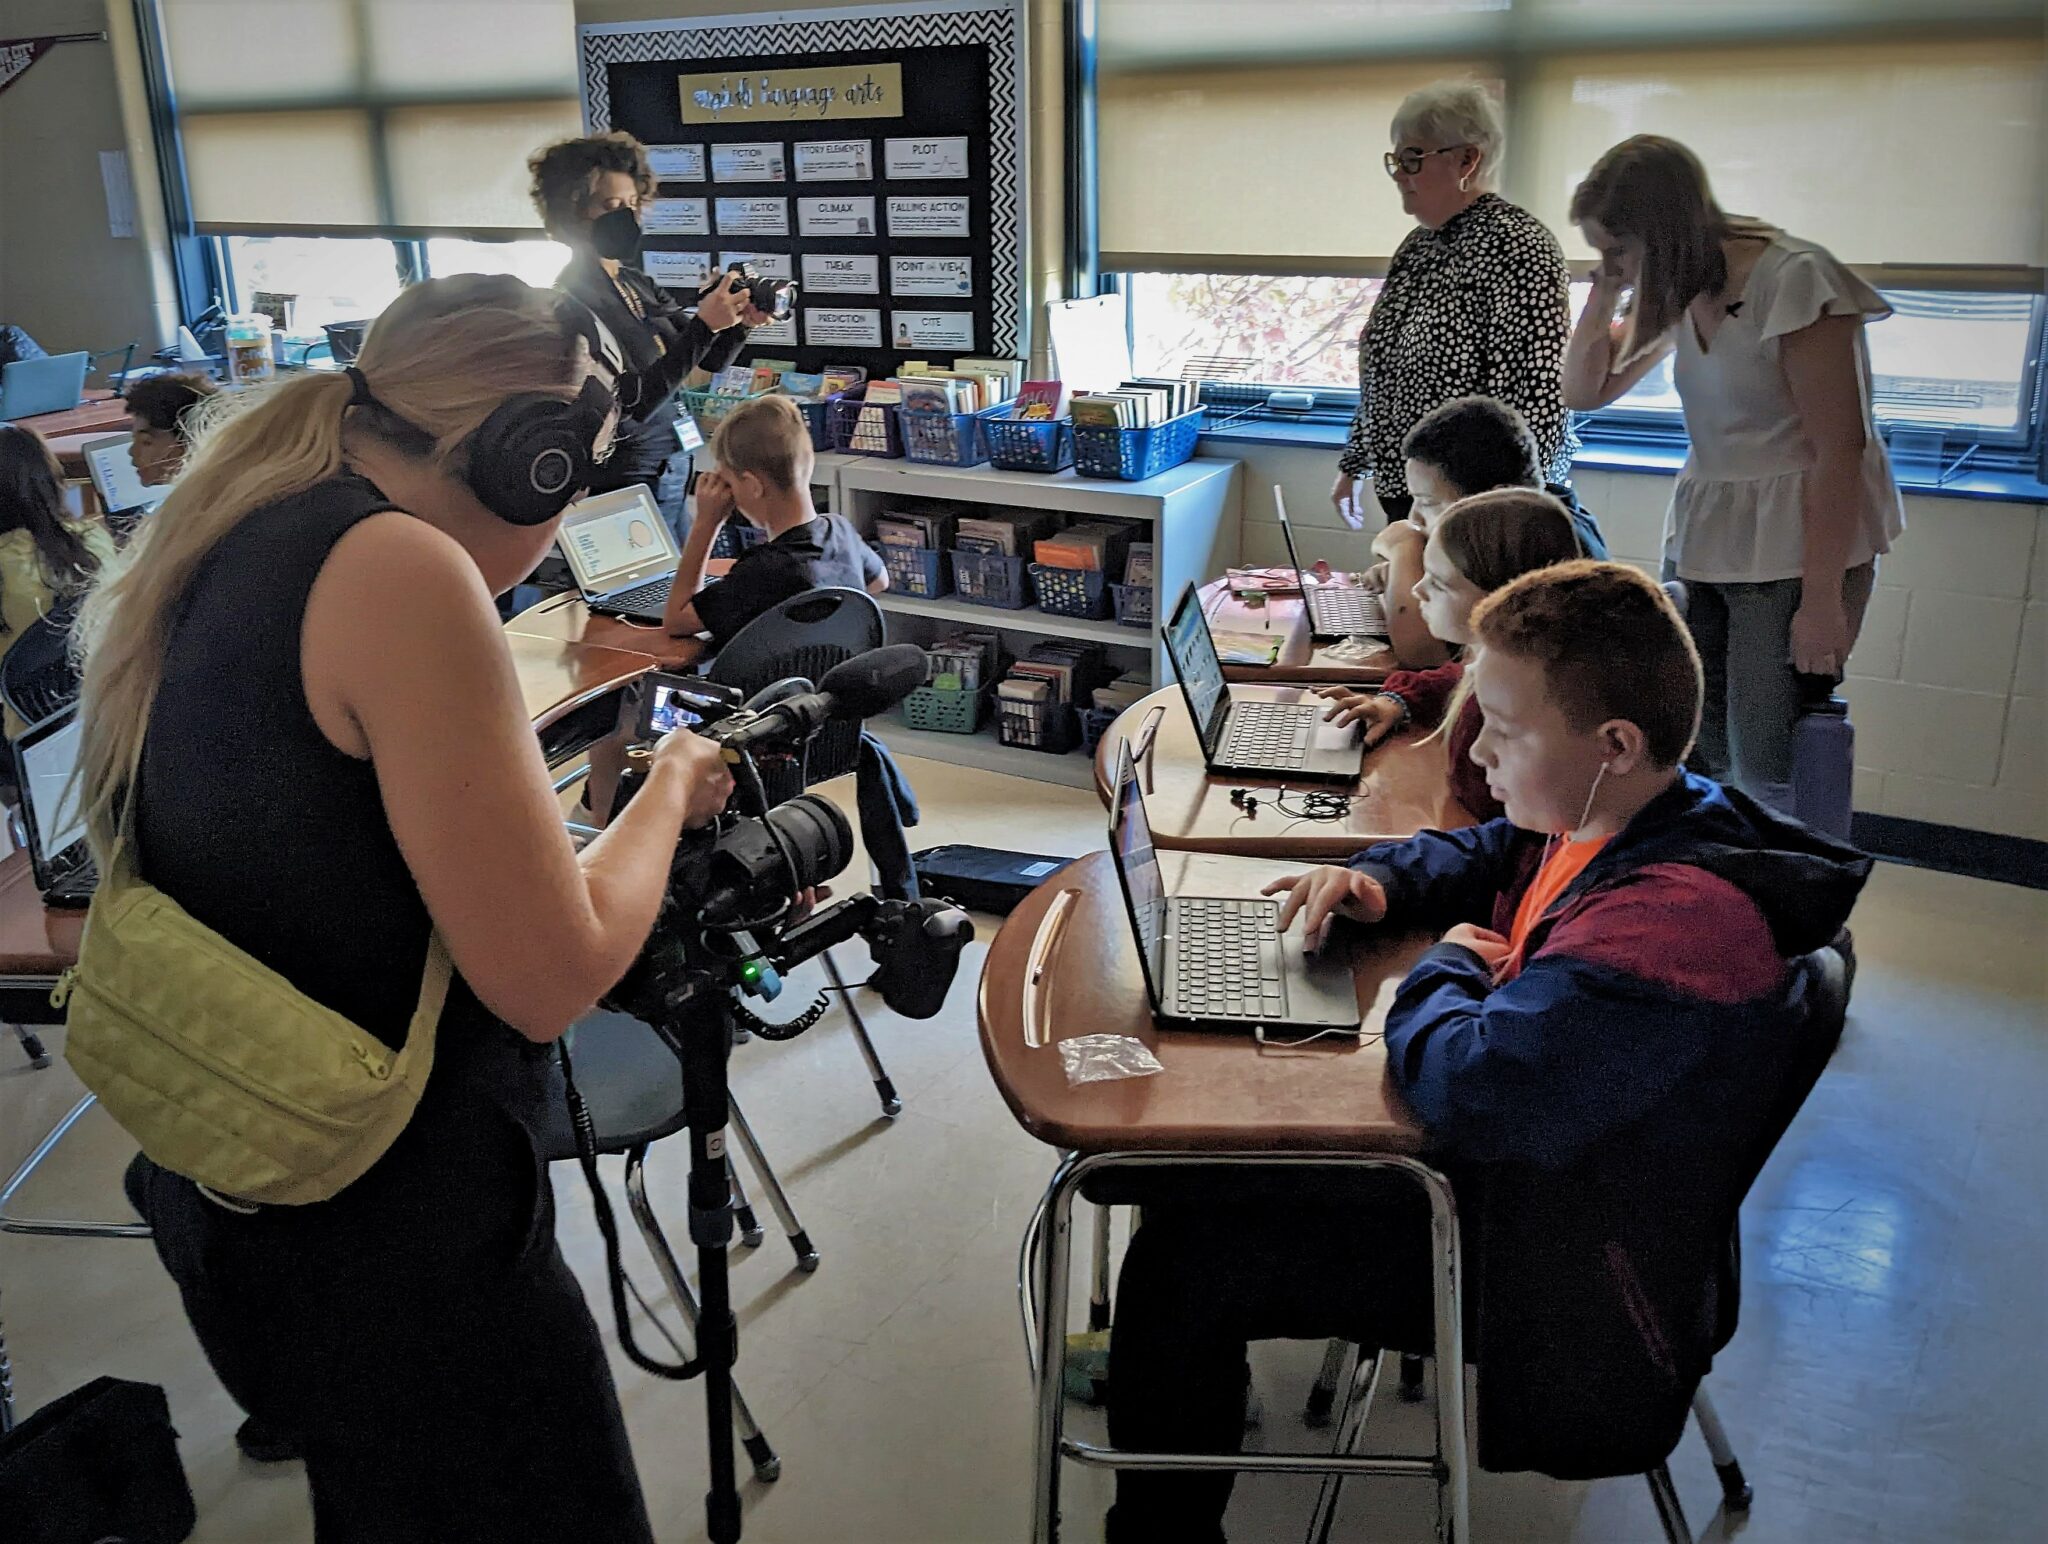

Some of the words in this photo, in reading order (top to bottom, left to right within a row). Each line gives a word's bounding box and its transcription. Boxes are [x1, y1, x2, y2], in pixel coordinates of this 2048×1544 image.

[761, 76, 836, 117] language
[845, 73, 884, 105] arts
[825, 143, 865, 154] ELEMENTS
[911, 143, 939, 155] PLOT
[749, 202, 781, 212] ACTION
[817, 203, 854, 213] CLIMAX
[890, 202, 927, 213] FALLING
[929, 202, 965, 213] ACTION
[824, 260, 854, 271] THEME
[896, 261, 925, 272] POINT
[938, 261, 965, 272] VIEW
[817, 313, 867, 324] PREDICTION
[921, 317, 942, 327] CITE
